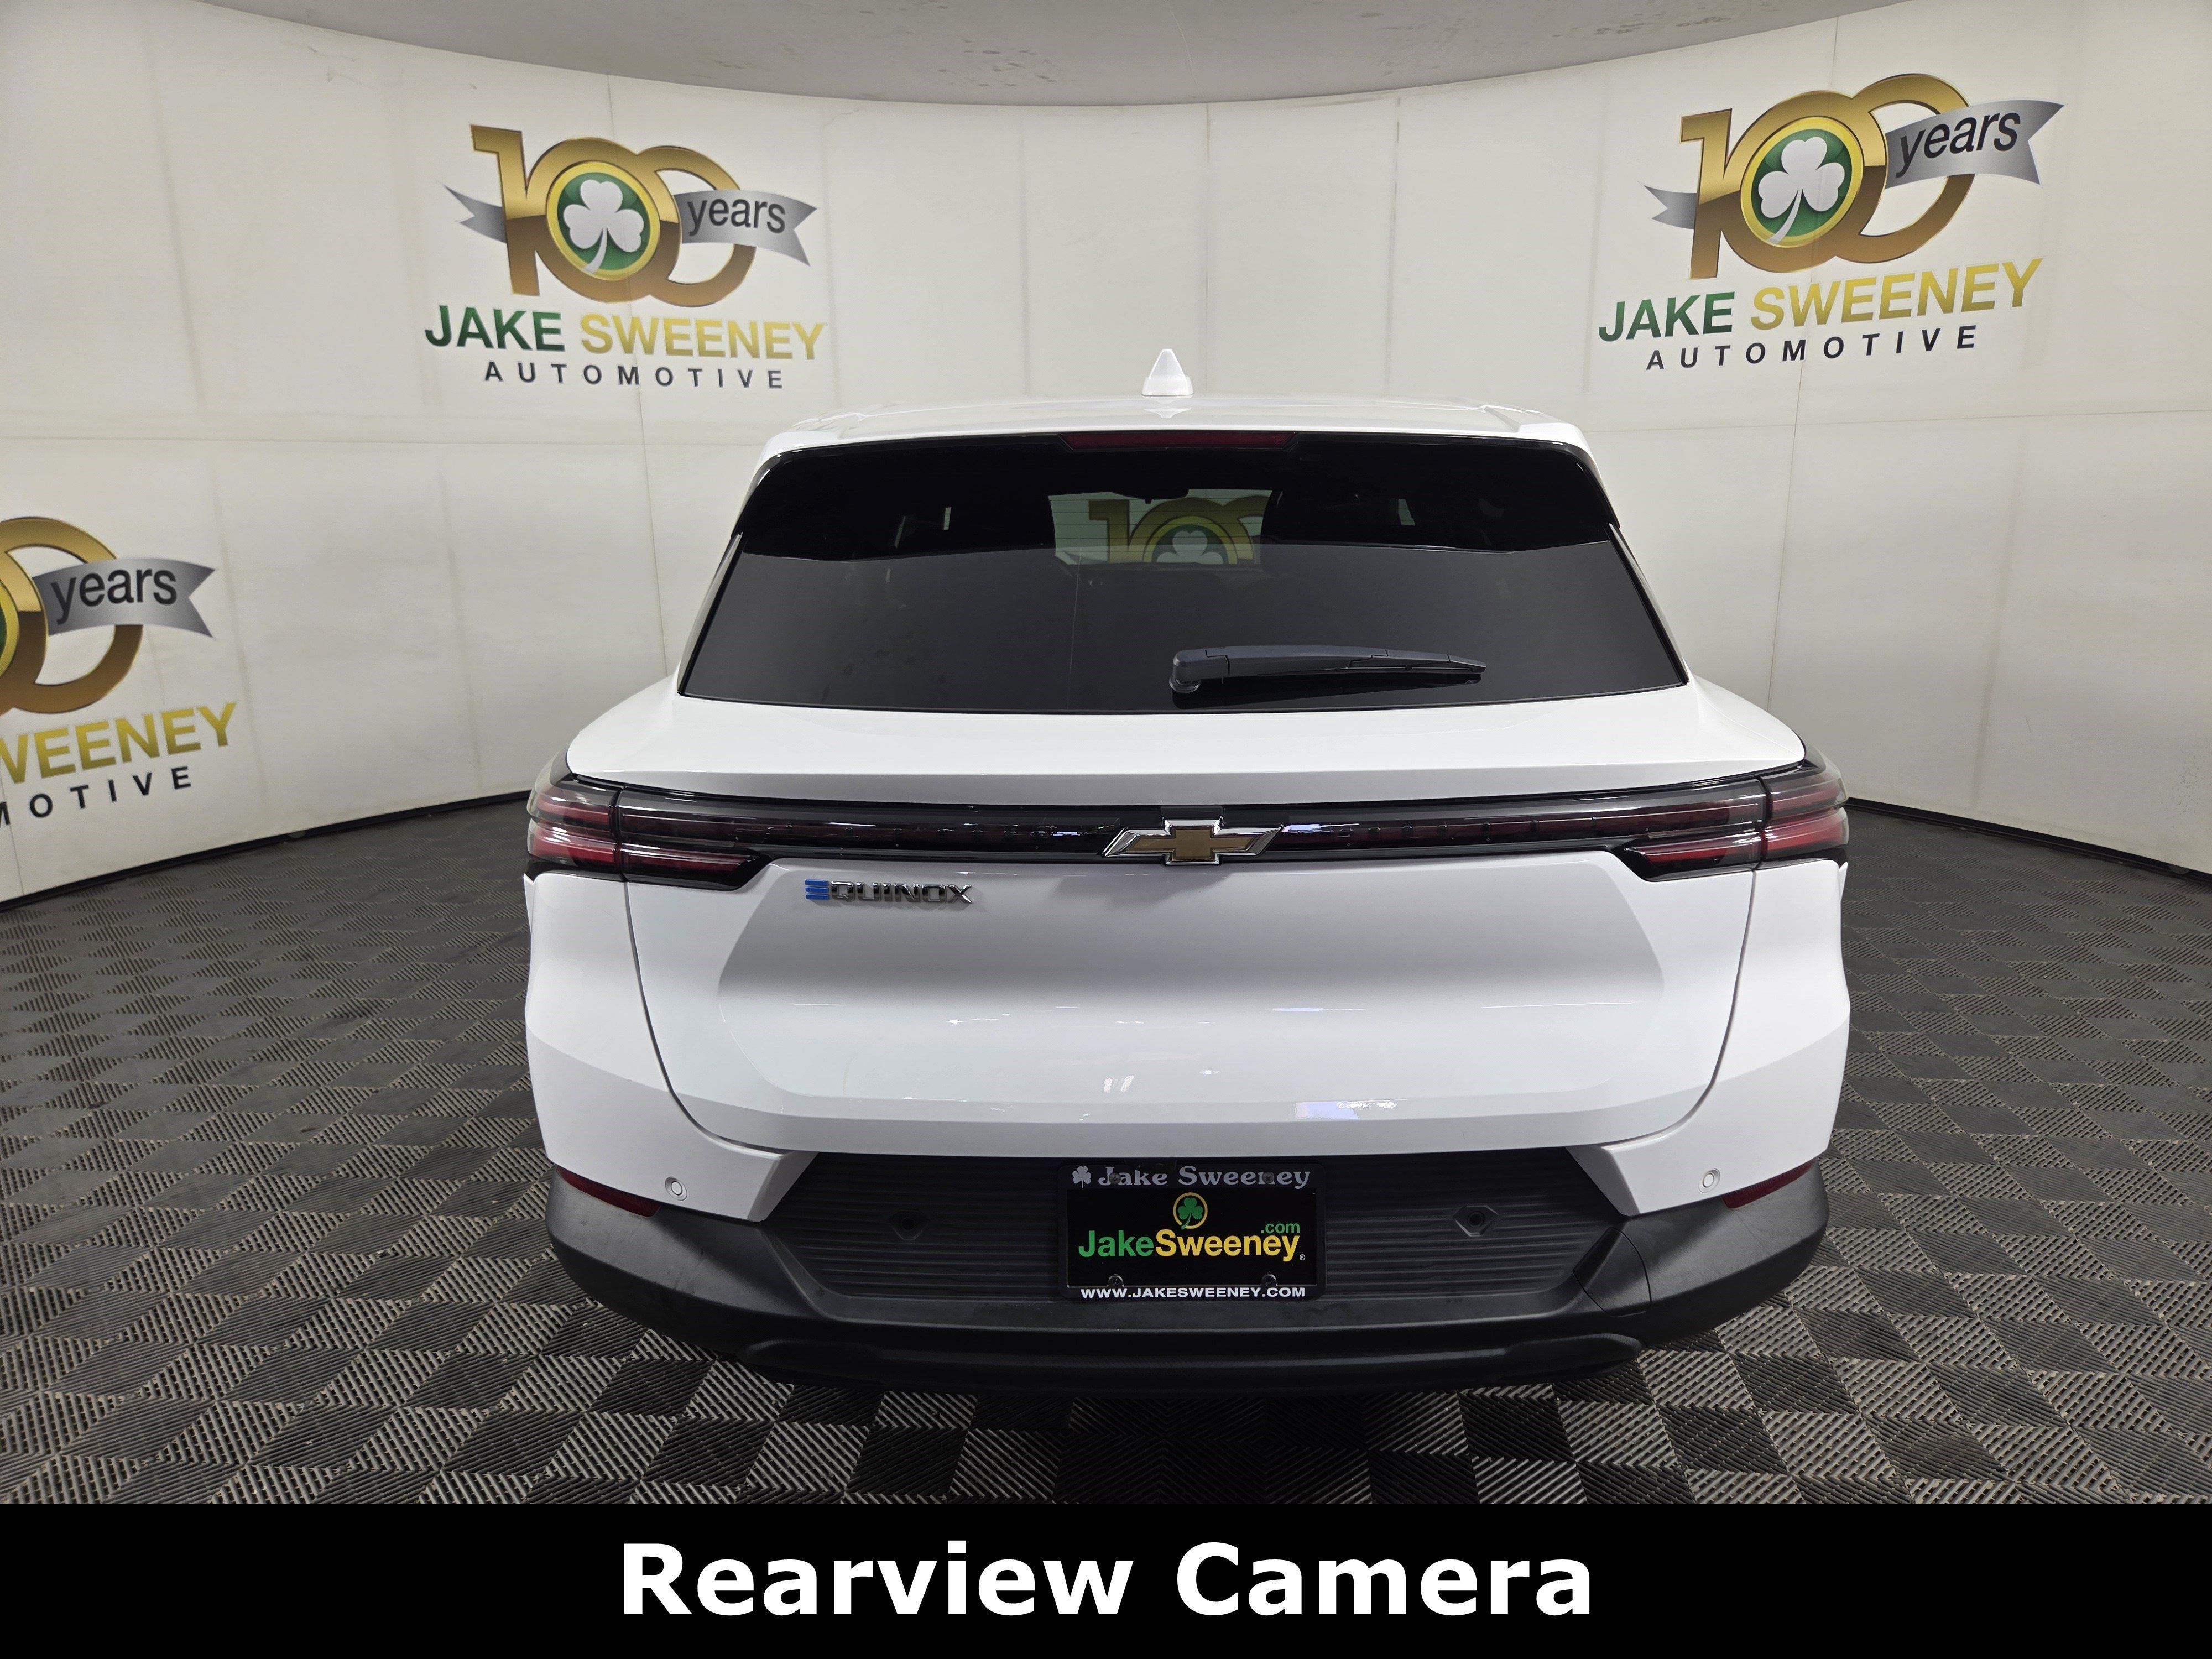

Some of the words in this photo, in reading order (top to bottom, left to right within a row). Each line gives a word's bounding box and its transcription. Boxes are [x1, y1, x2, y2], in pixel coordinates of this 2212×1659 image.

[1680, 73, 1976, 280] 100
[1895, 111, 2021, 179] years
[471, 125, 756, 307] 100
[688, 197, 786, 236] years
[1599, 291, 1735, 342] JAKE
[1751, 258, 2043, 331] SWEENEY
[425, 305, 565, 352] JAKE
[581, 313, 825, 361] SWEENEY
[1646, 325, 1976, 371] AUTOMOTIVE
[484, 361, 782, 389] AUTOMOTIVE
[51, 568, 178, 624] years
[805, 879, 973, 904] EQUINOX
[1098, 1166, 1168, 1186] Jake
[1178, 1166, 1311, 1190] Sweeney
[1080, 1287, 1305, 1298] WWW.JAKESWEENEY.COM
